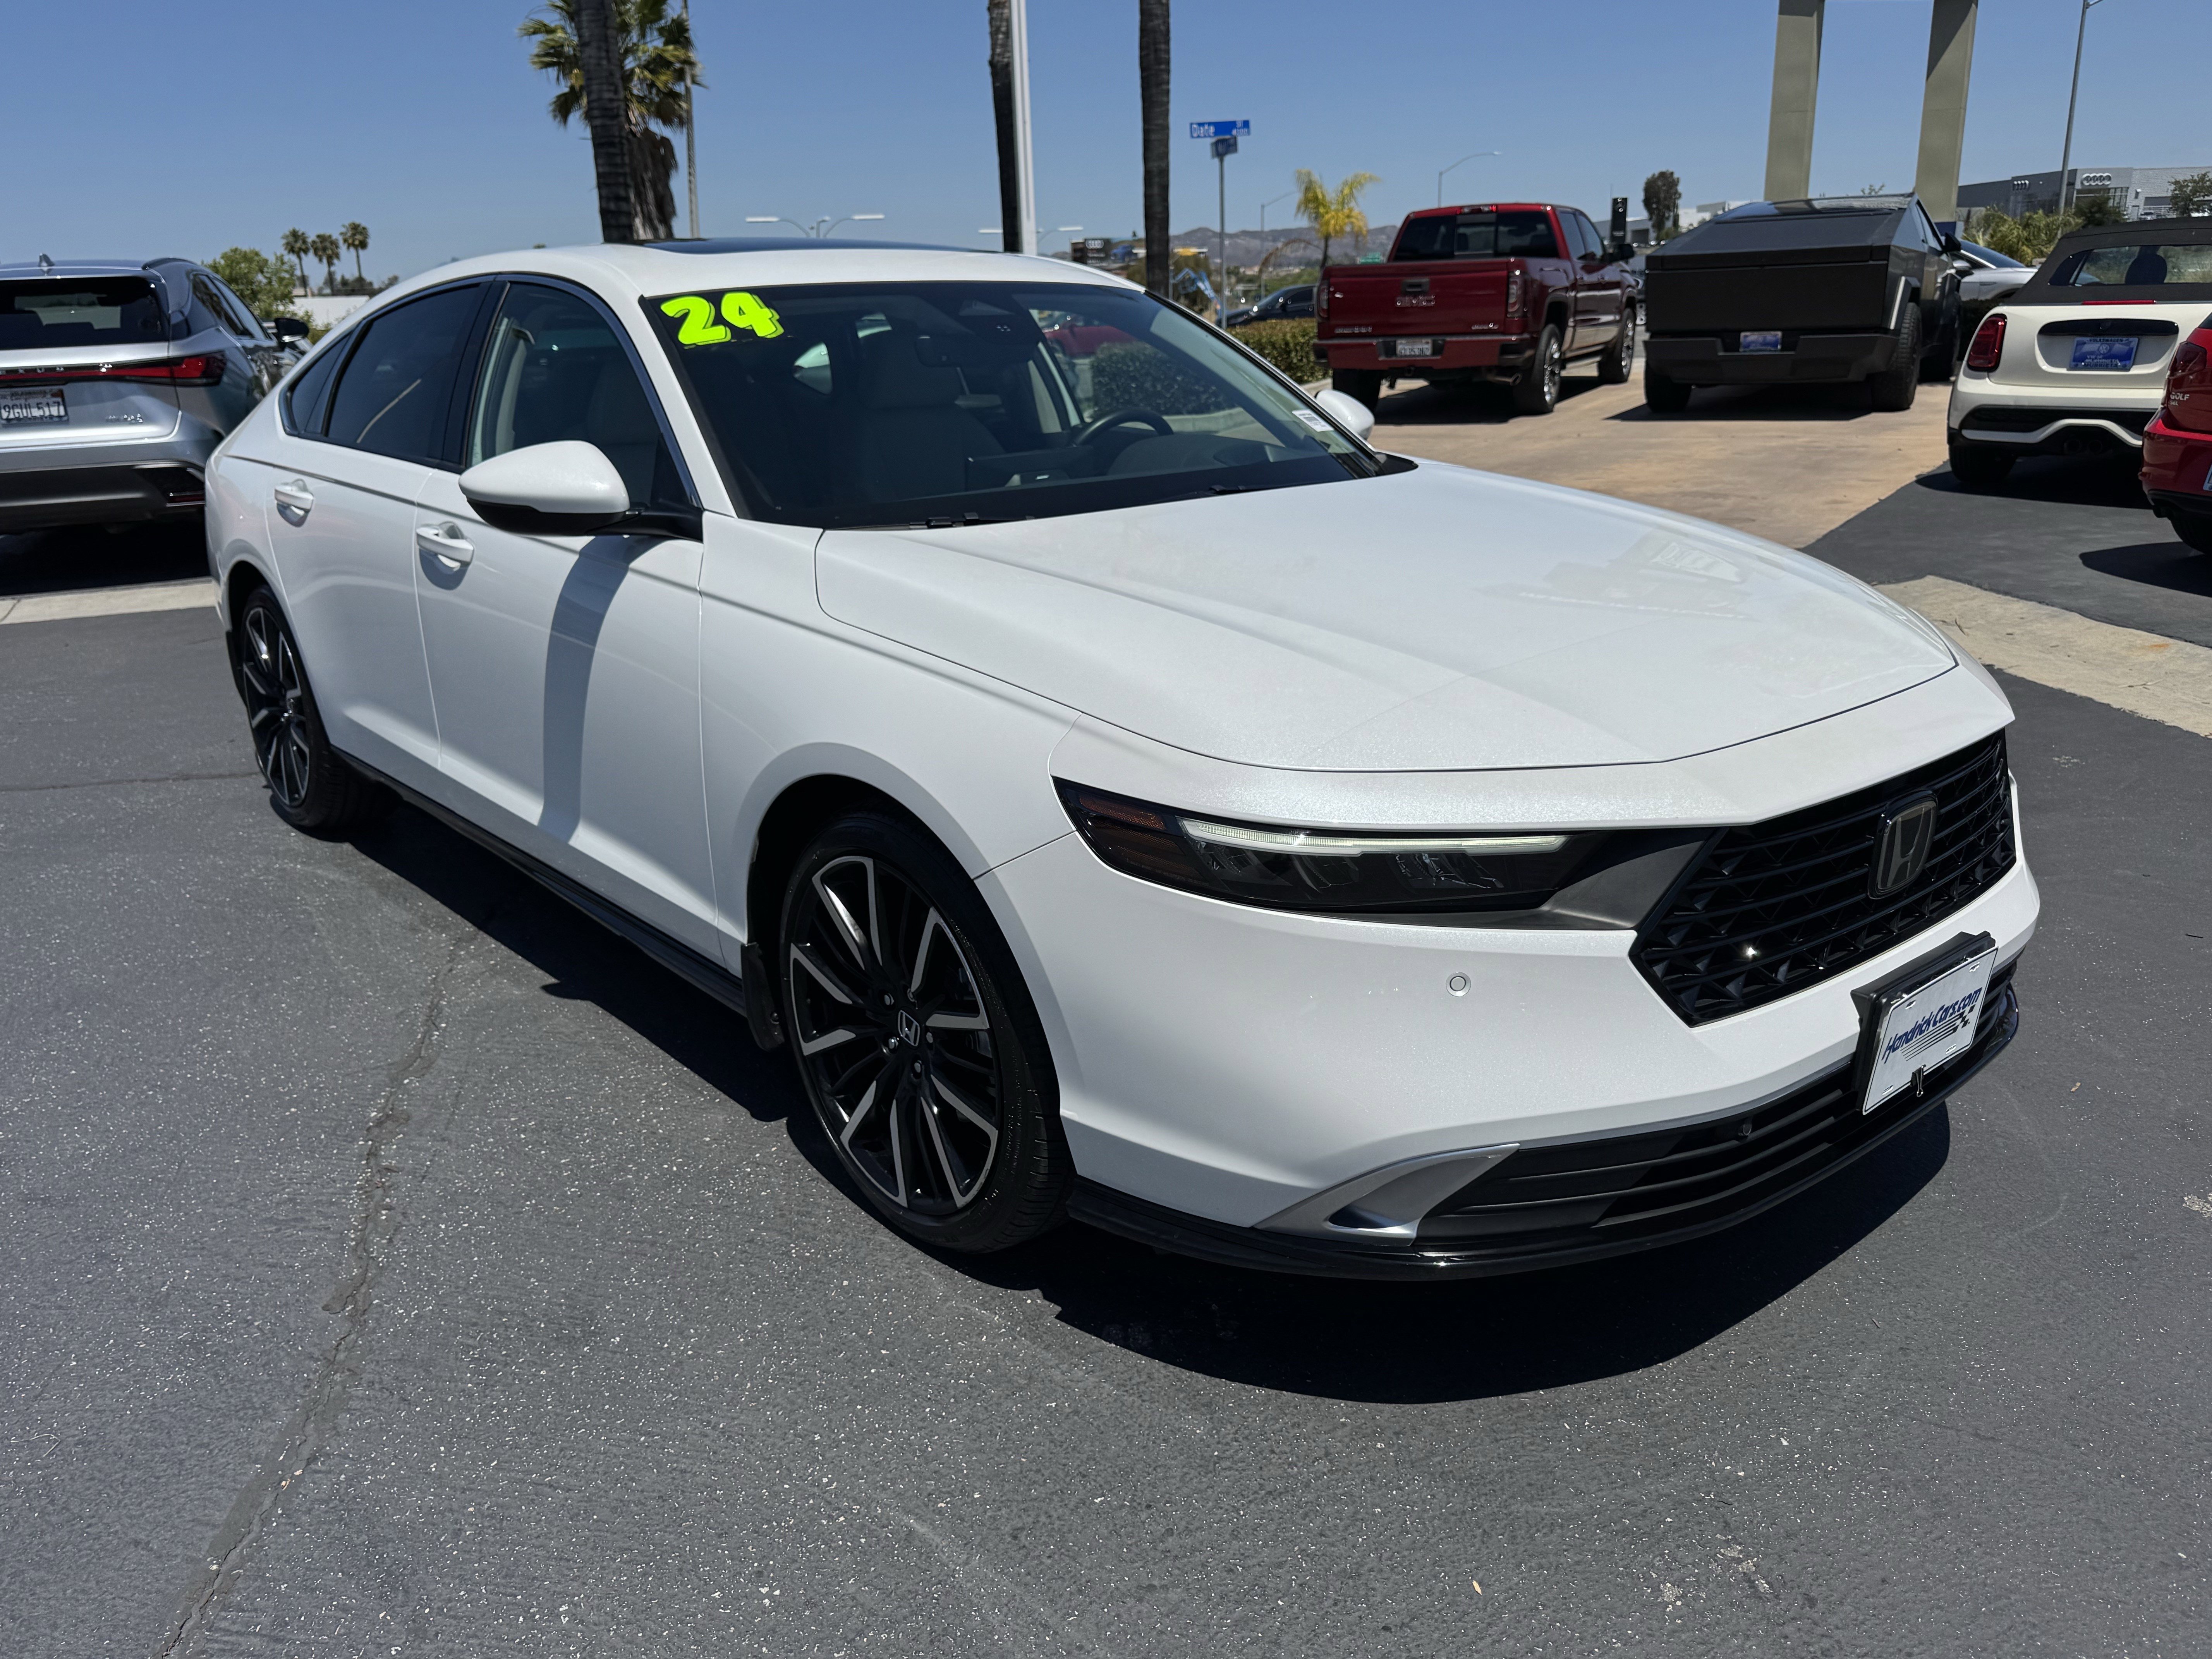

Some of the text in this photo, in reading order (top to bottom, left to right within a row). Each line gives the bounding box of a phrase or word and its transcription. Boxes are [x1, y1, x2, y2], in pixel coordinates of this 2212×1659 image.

[1192, 124, 1215, 137] Date
[660, 292, 784, 346] 24
[2170, 392, 2190, 401] GOLF
[1881, 987, 1982, 1064] HendrickCars.com
